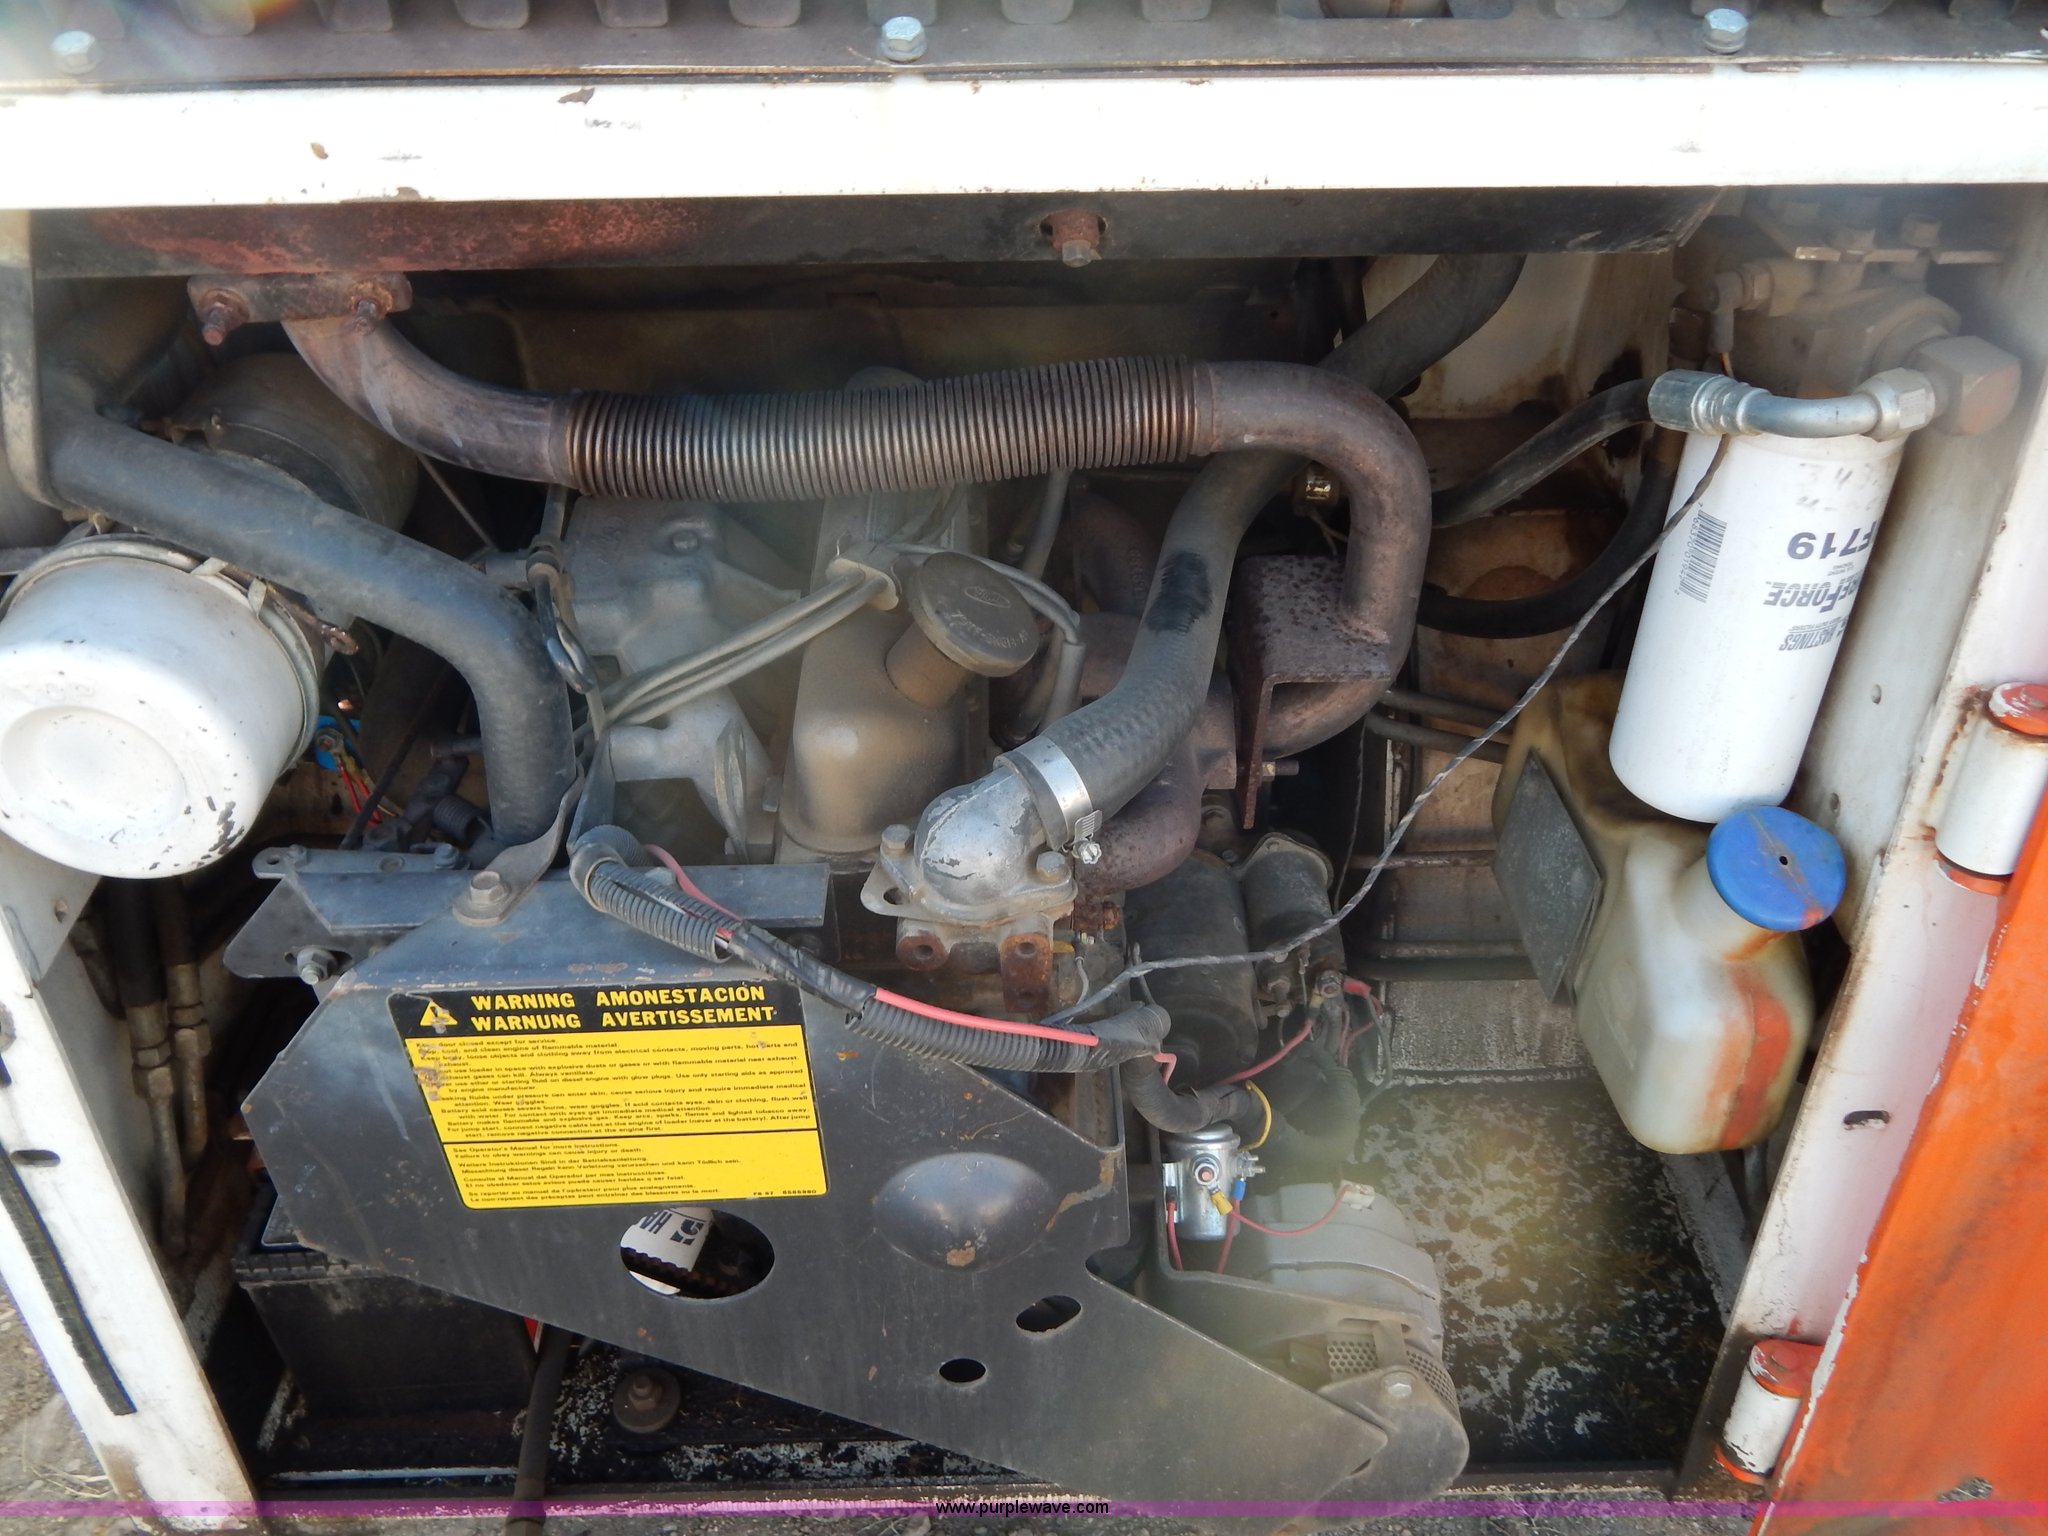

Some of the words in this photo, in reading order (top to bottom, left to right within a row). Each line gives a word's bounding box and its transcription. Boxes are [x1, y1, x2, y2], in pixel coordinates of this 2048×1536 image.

[471, 993, 576, 1011] WARNING
[471, 1013, 582, 1032] WARNUNG
[602, 1006, 774, 1028] AVERTISSEMENT
